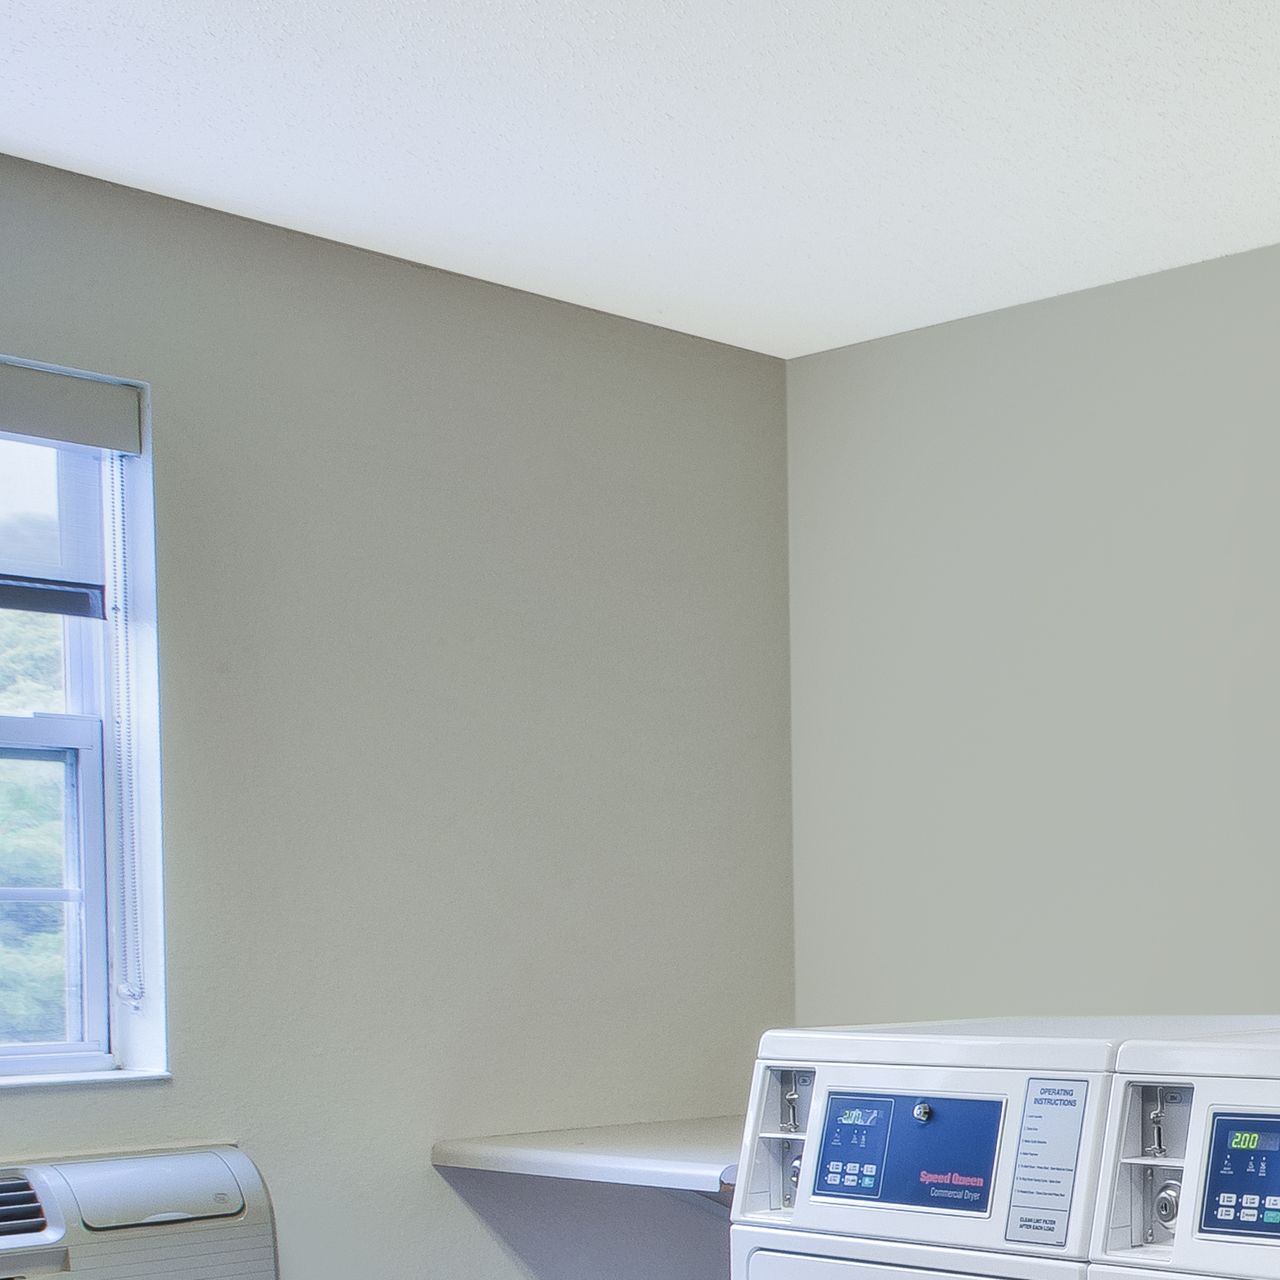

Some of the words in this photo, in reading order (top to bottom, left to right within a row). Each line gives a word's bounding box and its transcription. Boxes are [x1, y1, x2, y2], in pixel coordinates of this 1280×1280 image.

[1040, 1088, 1073, 1096] OPERATING
[1034, 1098, 1076, 1107] INSTRUCTIONS
[1232, 1133, 1258, 1148] 2.00
[920, 1171, 951, 1184] Speed
[952, 1173, 983, 1186] Queen
[931, 1187, 963, 1199] Commercial
[964, 1190, 980, 1201] Dryer
